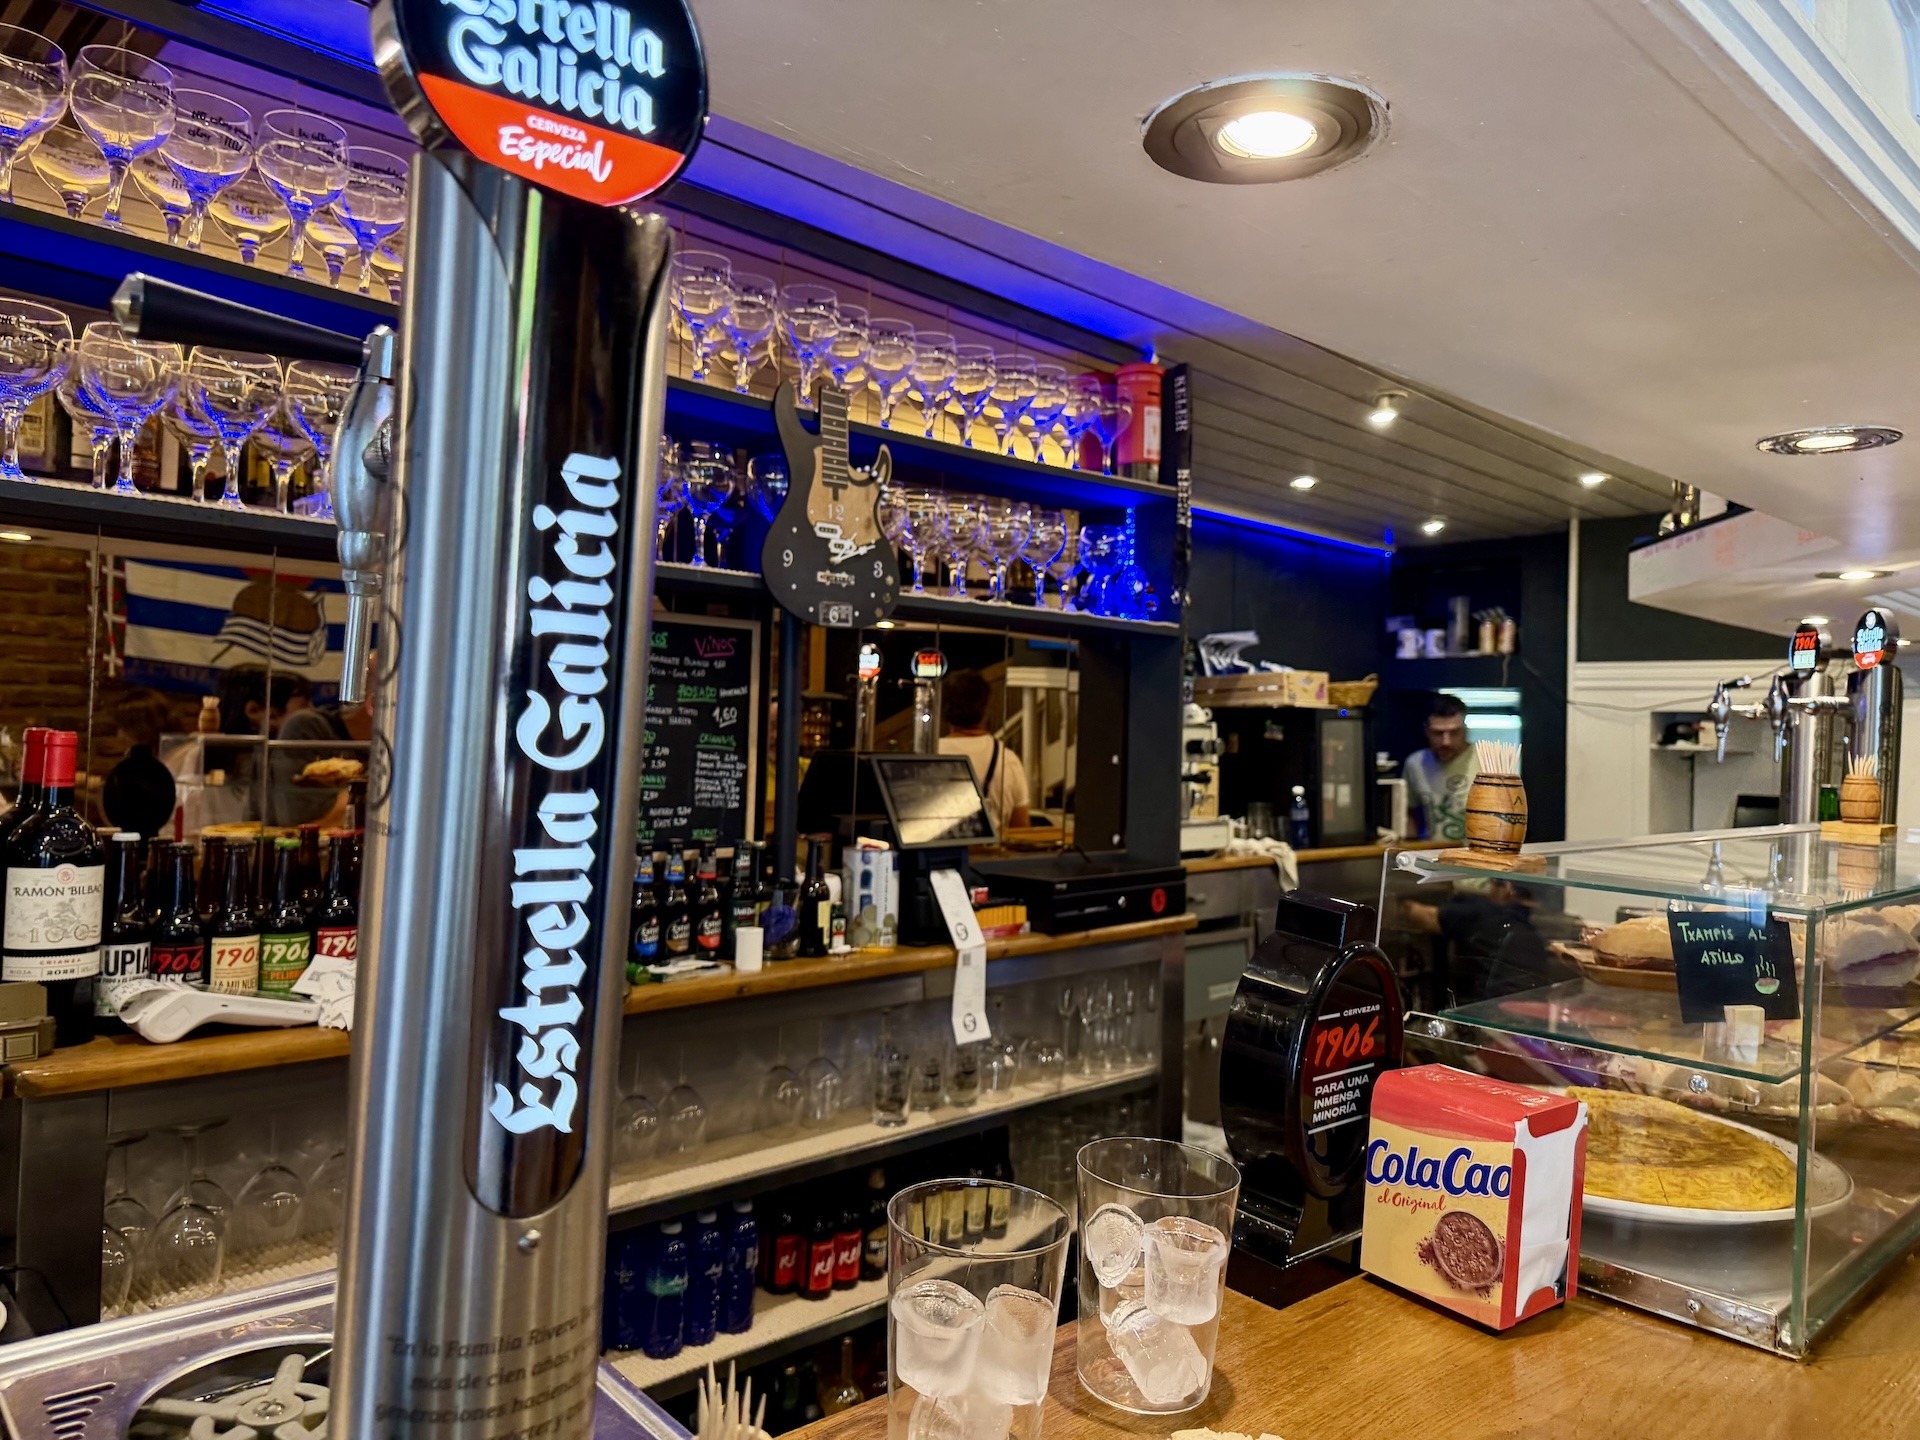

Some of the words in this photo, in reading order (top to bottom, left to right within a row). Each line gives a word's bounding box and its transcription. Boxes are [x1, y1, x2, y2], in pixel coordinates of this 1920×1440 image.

[440, 0, 665, 78] strella
[450, 15, 656, 135] Galicia
[526, 115, 588, 144] CERVEZA
[498, 126, 613, 183] Especial
[827, 503, 845, 521] 12
[783, 549, 794, 567] 9
[873, 561, 883, 578] 3
[516, 451, 622, 771] Galicia
[829, 606, 840, 624] 6
[1795, 635, 1816, 650] 1906
[13, 885, 65, 897] RAMÓN
[322, 934, 358, 957] 190
[1748, 928, 1767, 940] AL
[40, 958, 82, 966] CRIANZA
[100, 946, 151, 977] UPIA
[216, 945, 258, 967] 190
[263, 940, 311, 964] 1906
[488, 787, 599, 1134] Estrella
[1343, 1004, 1380, 1016] CERVEZAS
[1314, 1016, 1379, 1068] 1906
[1315, 1080, 1345, 1096] PARA
[1347, 1074, 1369, 1087] UNA
[1313, 1089, 1361, 1110] INMENSA
[1312, 1101, 1357, 1123] MINORÍA
[1366, 1139, 1512, 1198] ColaCao
[1378, 1188, 1390, 1204] el
[1392, 1192, 1446, 1214] Original
[444, 1334, 522, 1359] Familia
